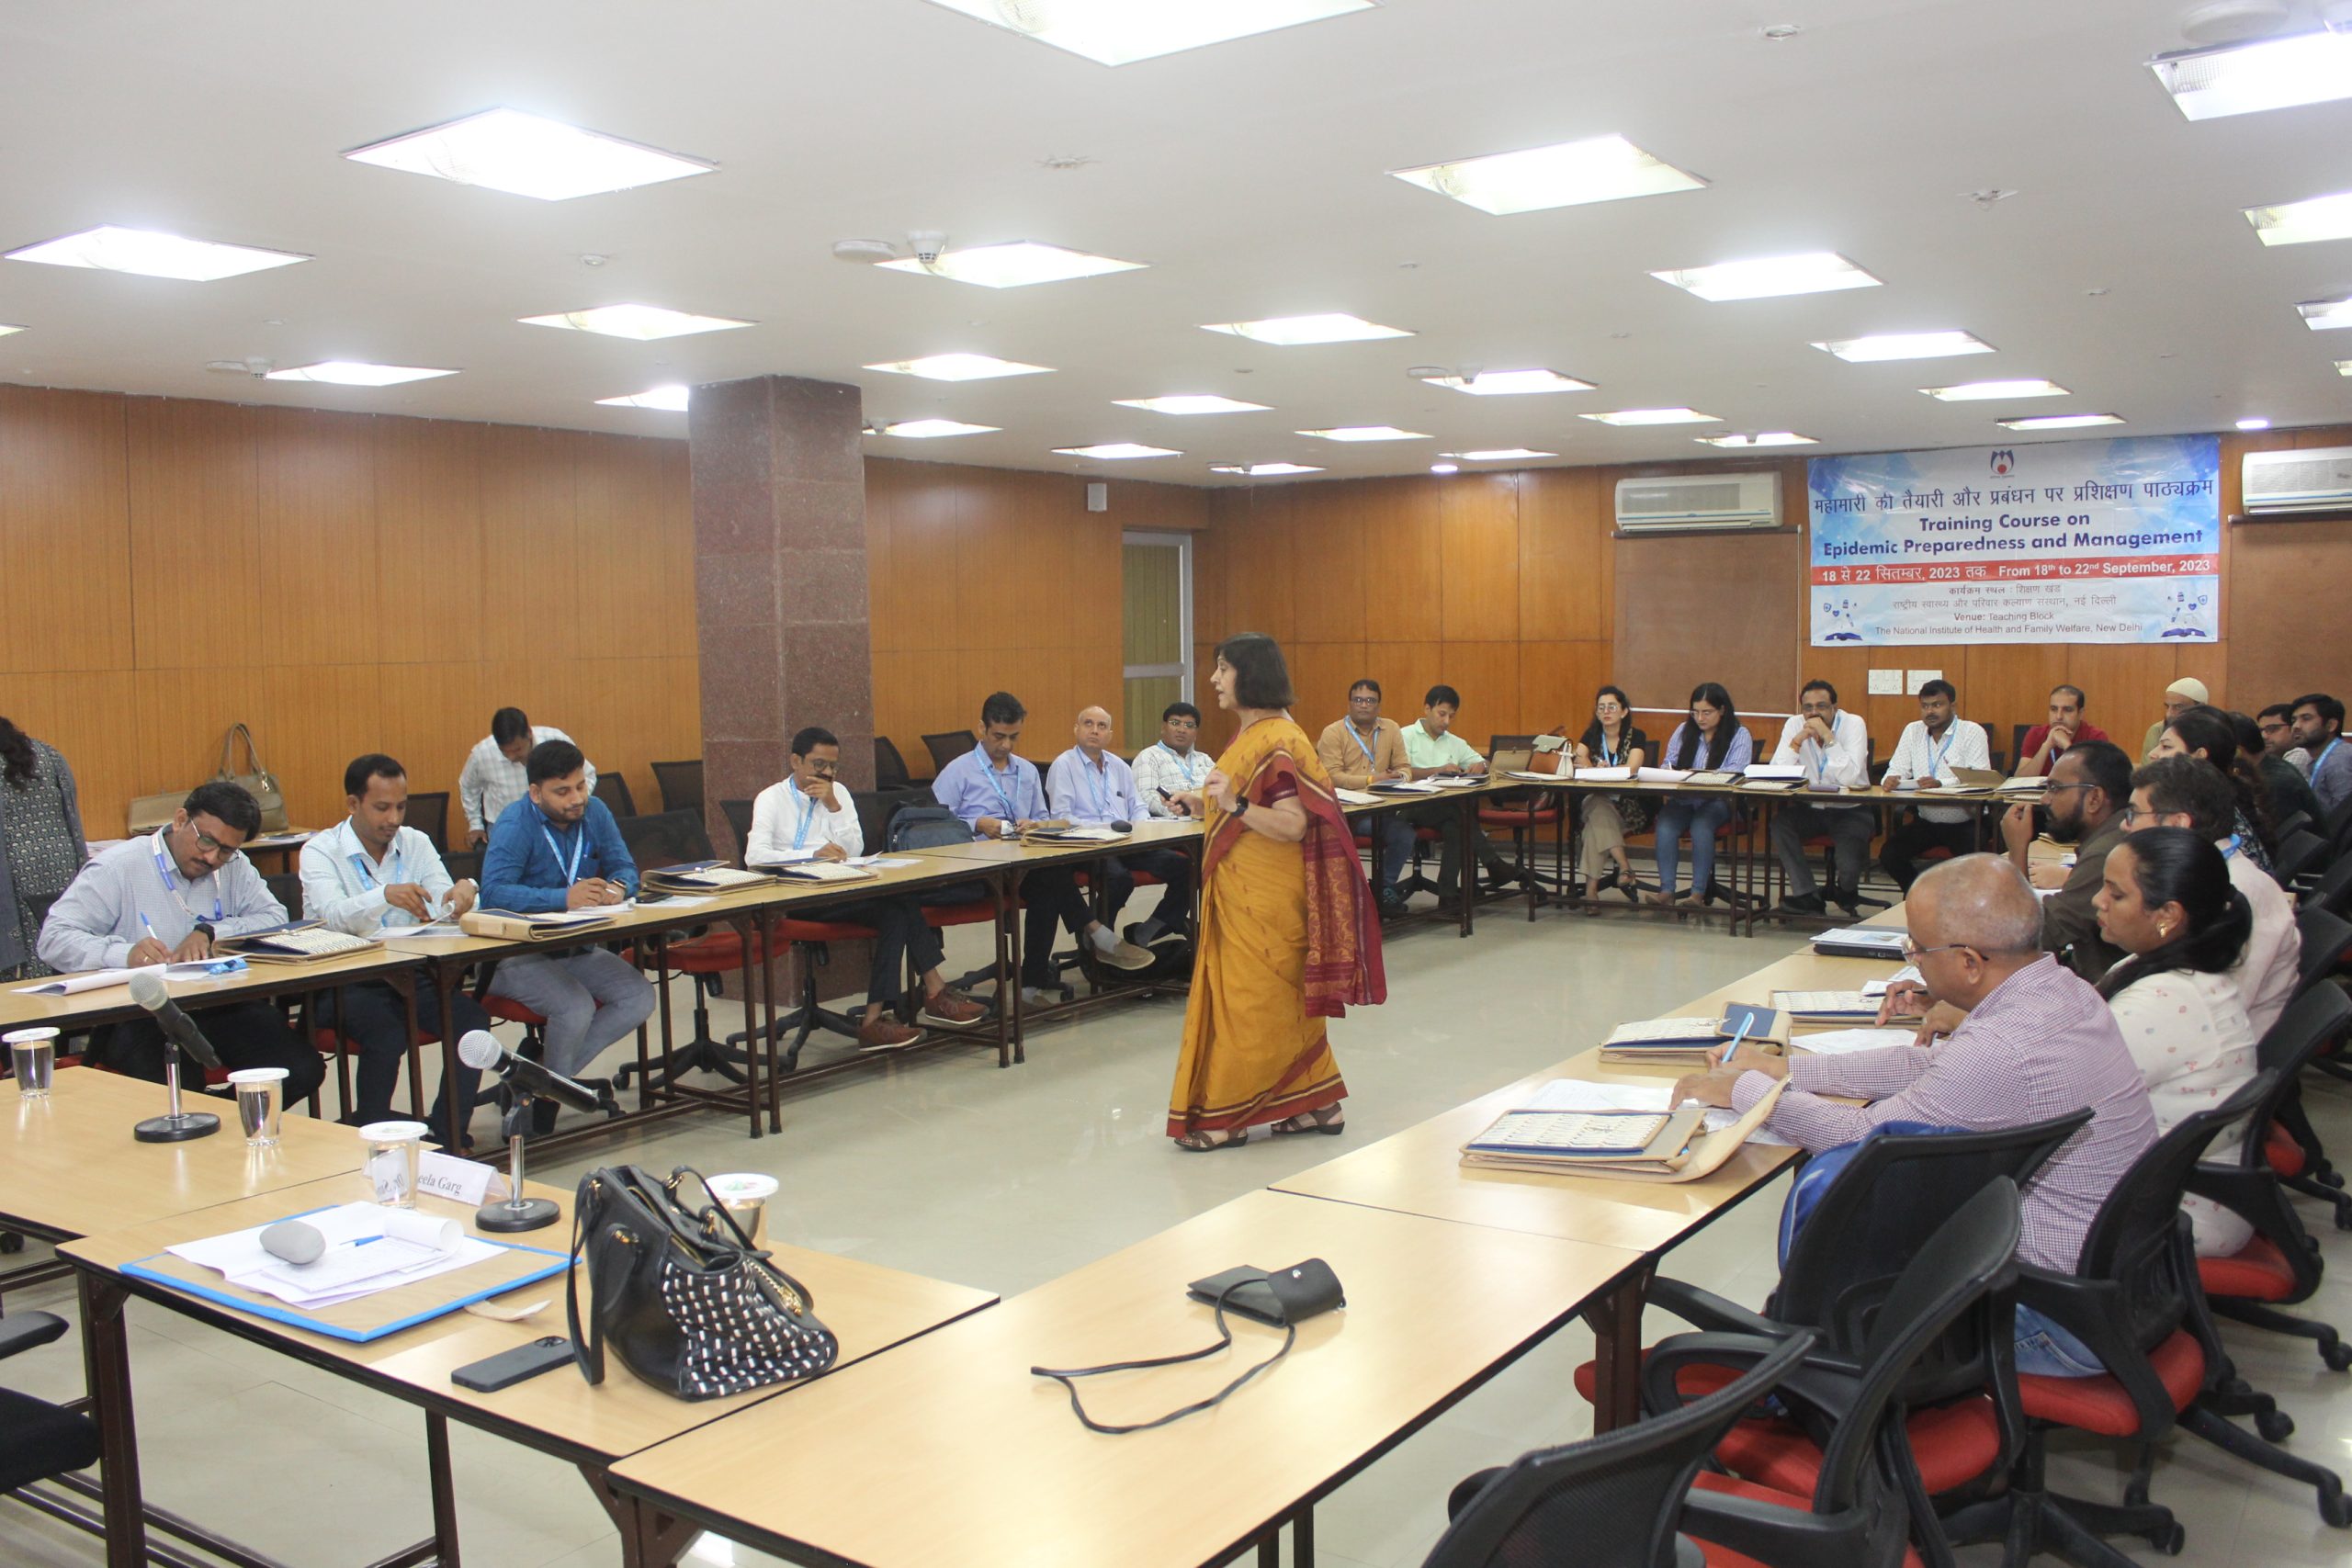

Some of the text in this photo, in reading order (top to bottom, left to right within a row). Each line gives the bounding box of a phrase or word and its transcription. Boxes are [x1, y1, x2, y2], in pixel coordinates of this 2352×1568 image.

[1815, 479, 2213, 513] महामारी की तैयारी और प्रबंधन पर प्रशिक्षण पाठ्यक्रम
[1919, 513, 2090, 533] Training Course on
[1824, 529, 2203, 558] Epidemic Preparedness and Management
[1823, 570, 1837, 581] 18
[1841, 566, 1851, 581] से
[1856, 570, 1871, 581] 22
[1929, 567, 1961, 580] 2023
[1965, 566, 1986, 579] तक
[1998, 559, 2210, 577] From 18th to 22nd September, 2023
[1949, 585, 1981, 595] कार्यक्रम
[1985, 586, 2006, 594] स्थल
[2016, 583, 2040, 593] शिक्षण
[1893, 599, 1917, 610] राष्ट्रीय
[1954, 597, 1968, 607] और
[1972, 597, 1998, 607] परिवार
[2003, 598, 2031, 606] कल्याण
[2074, 594, 2086, 606] नई
[2091, 594, 2117, 605] दिल्ली
[1953, 612, 2054, 622] Venue: Teaching Block
[1875, 623, 2143, 635] The National Institute of Health and Family Welfare, New Delhi
[418, 1174, 462, 1196] eela Garg
